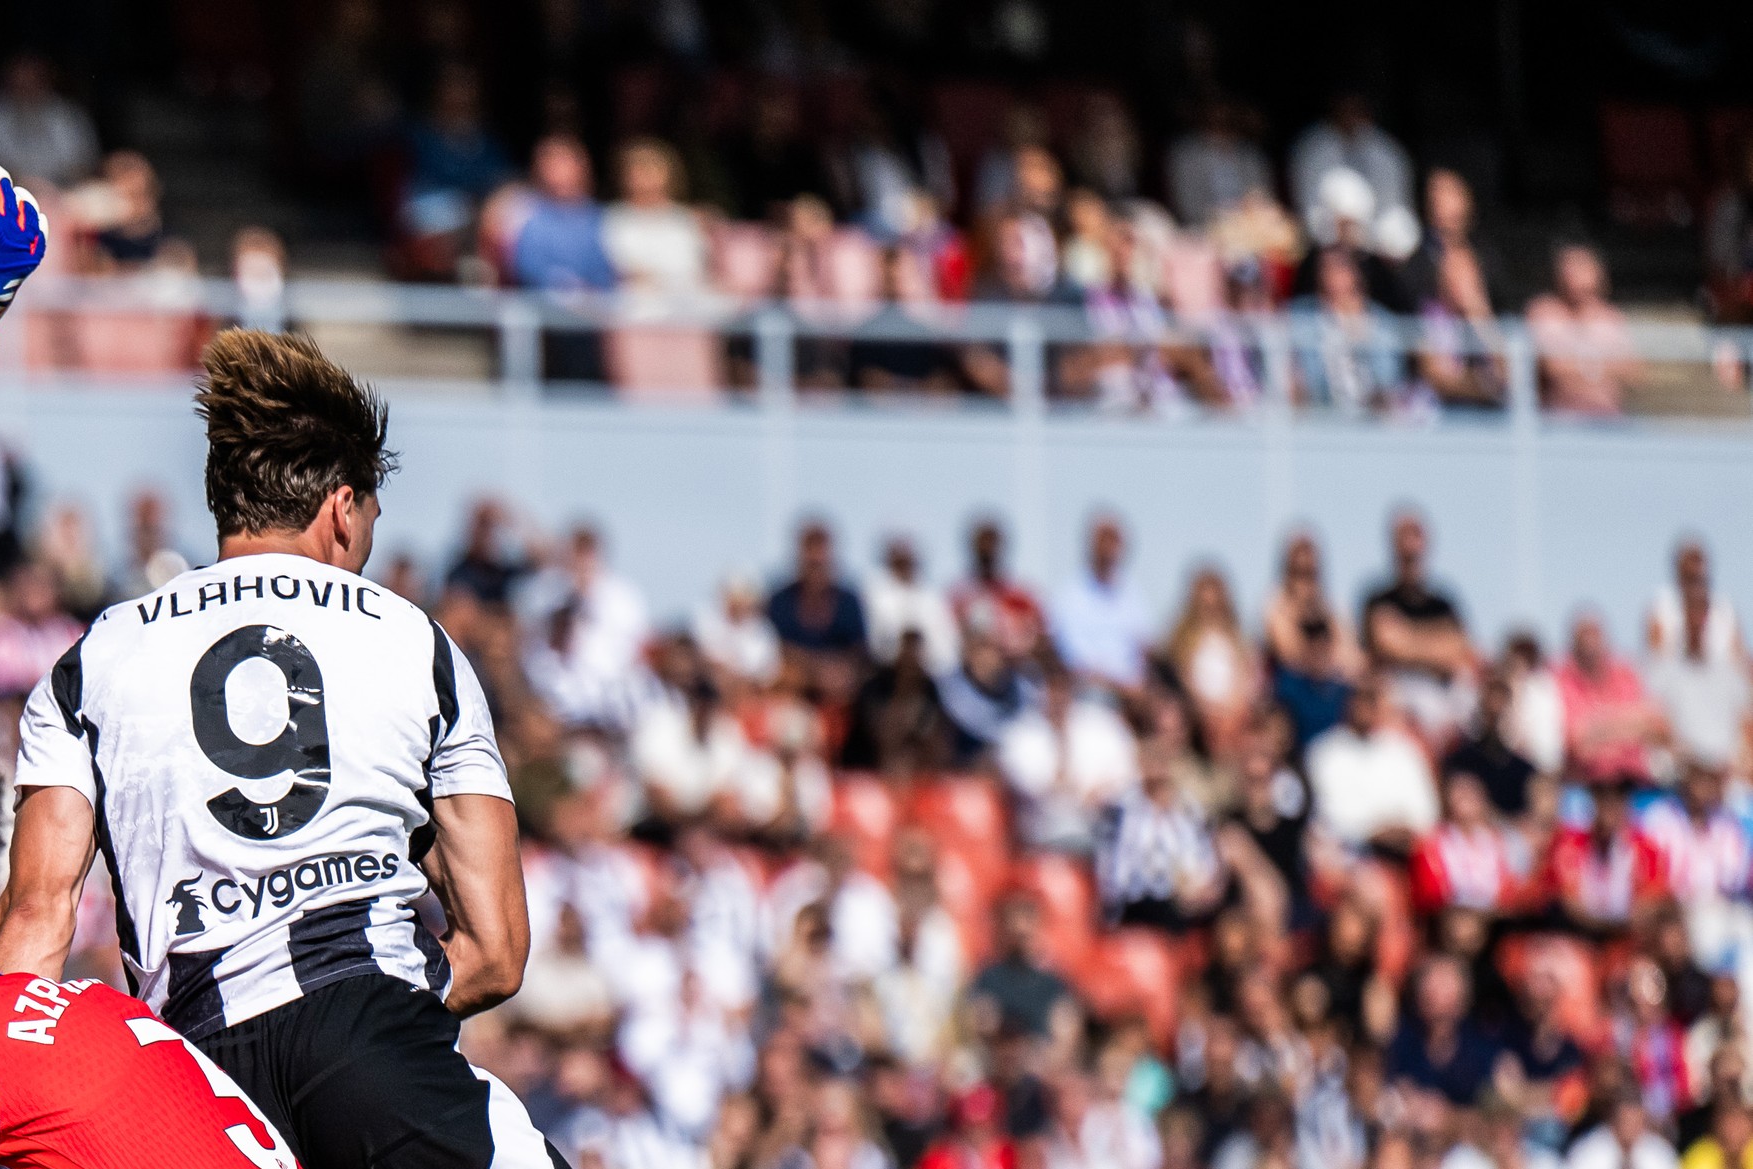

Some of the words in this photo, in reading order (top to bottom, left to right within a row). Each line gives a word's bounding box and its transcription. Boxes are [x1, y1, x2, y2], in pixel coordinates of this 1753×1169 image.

[136, 574, 382, 624] VLAHOVIC
[190, 624, 332, 840] 9
[210, 850, 400, 918] Cygames
